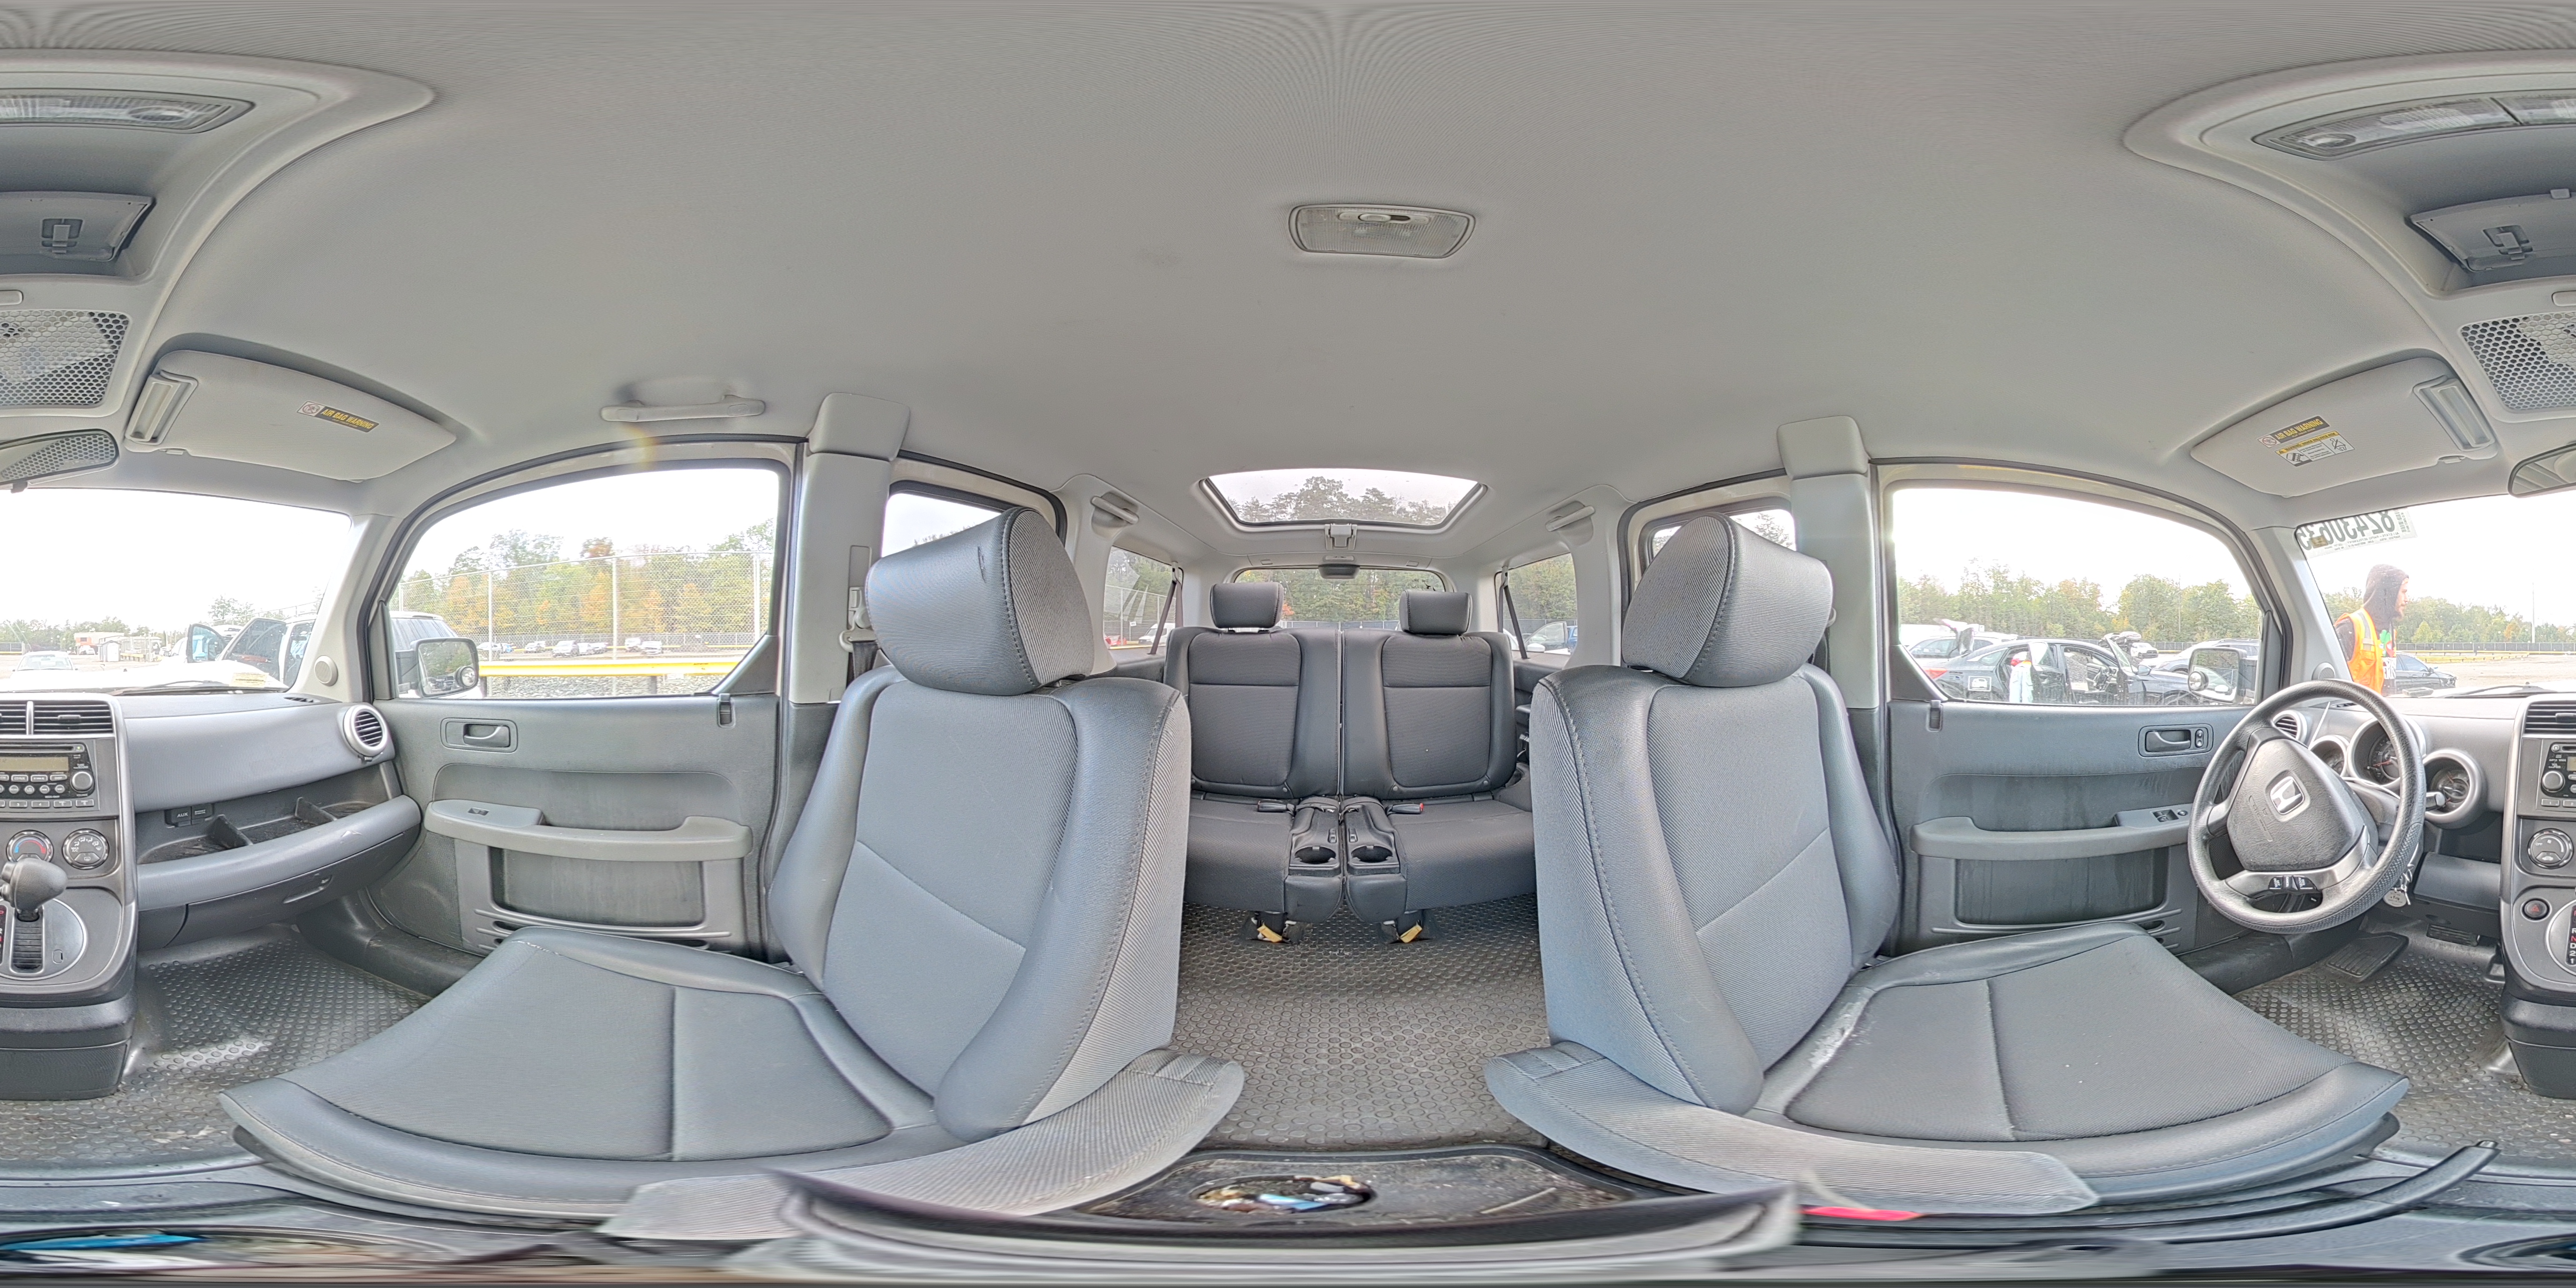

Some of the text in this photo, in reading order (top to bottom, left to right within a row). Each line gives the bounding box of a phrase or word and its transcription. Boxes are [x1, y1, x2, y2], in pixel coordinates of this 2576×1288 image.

[332, 412, 349, 421] BAG
[346, 416, 374, 429] WARNING
[2283, 428, 2298, 436] BAG
[2294, 418, 2323, 432] WARNING
